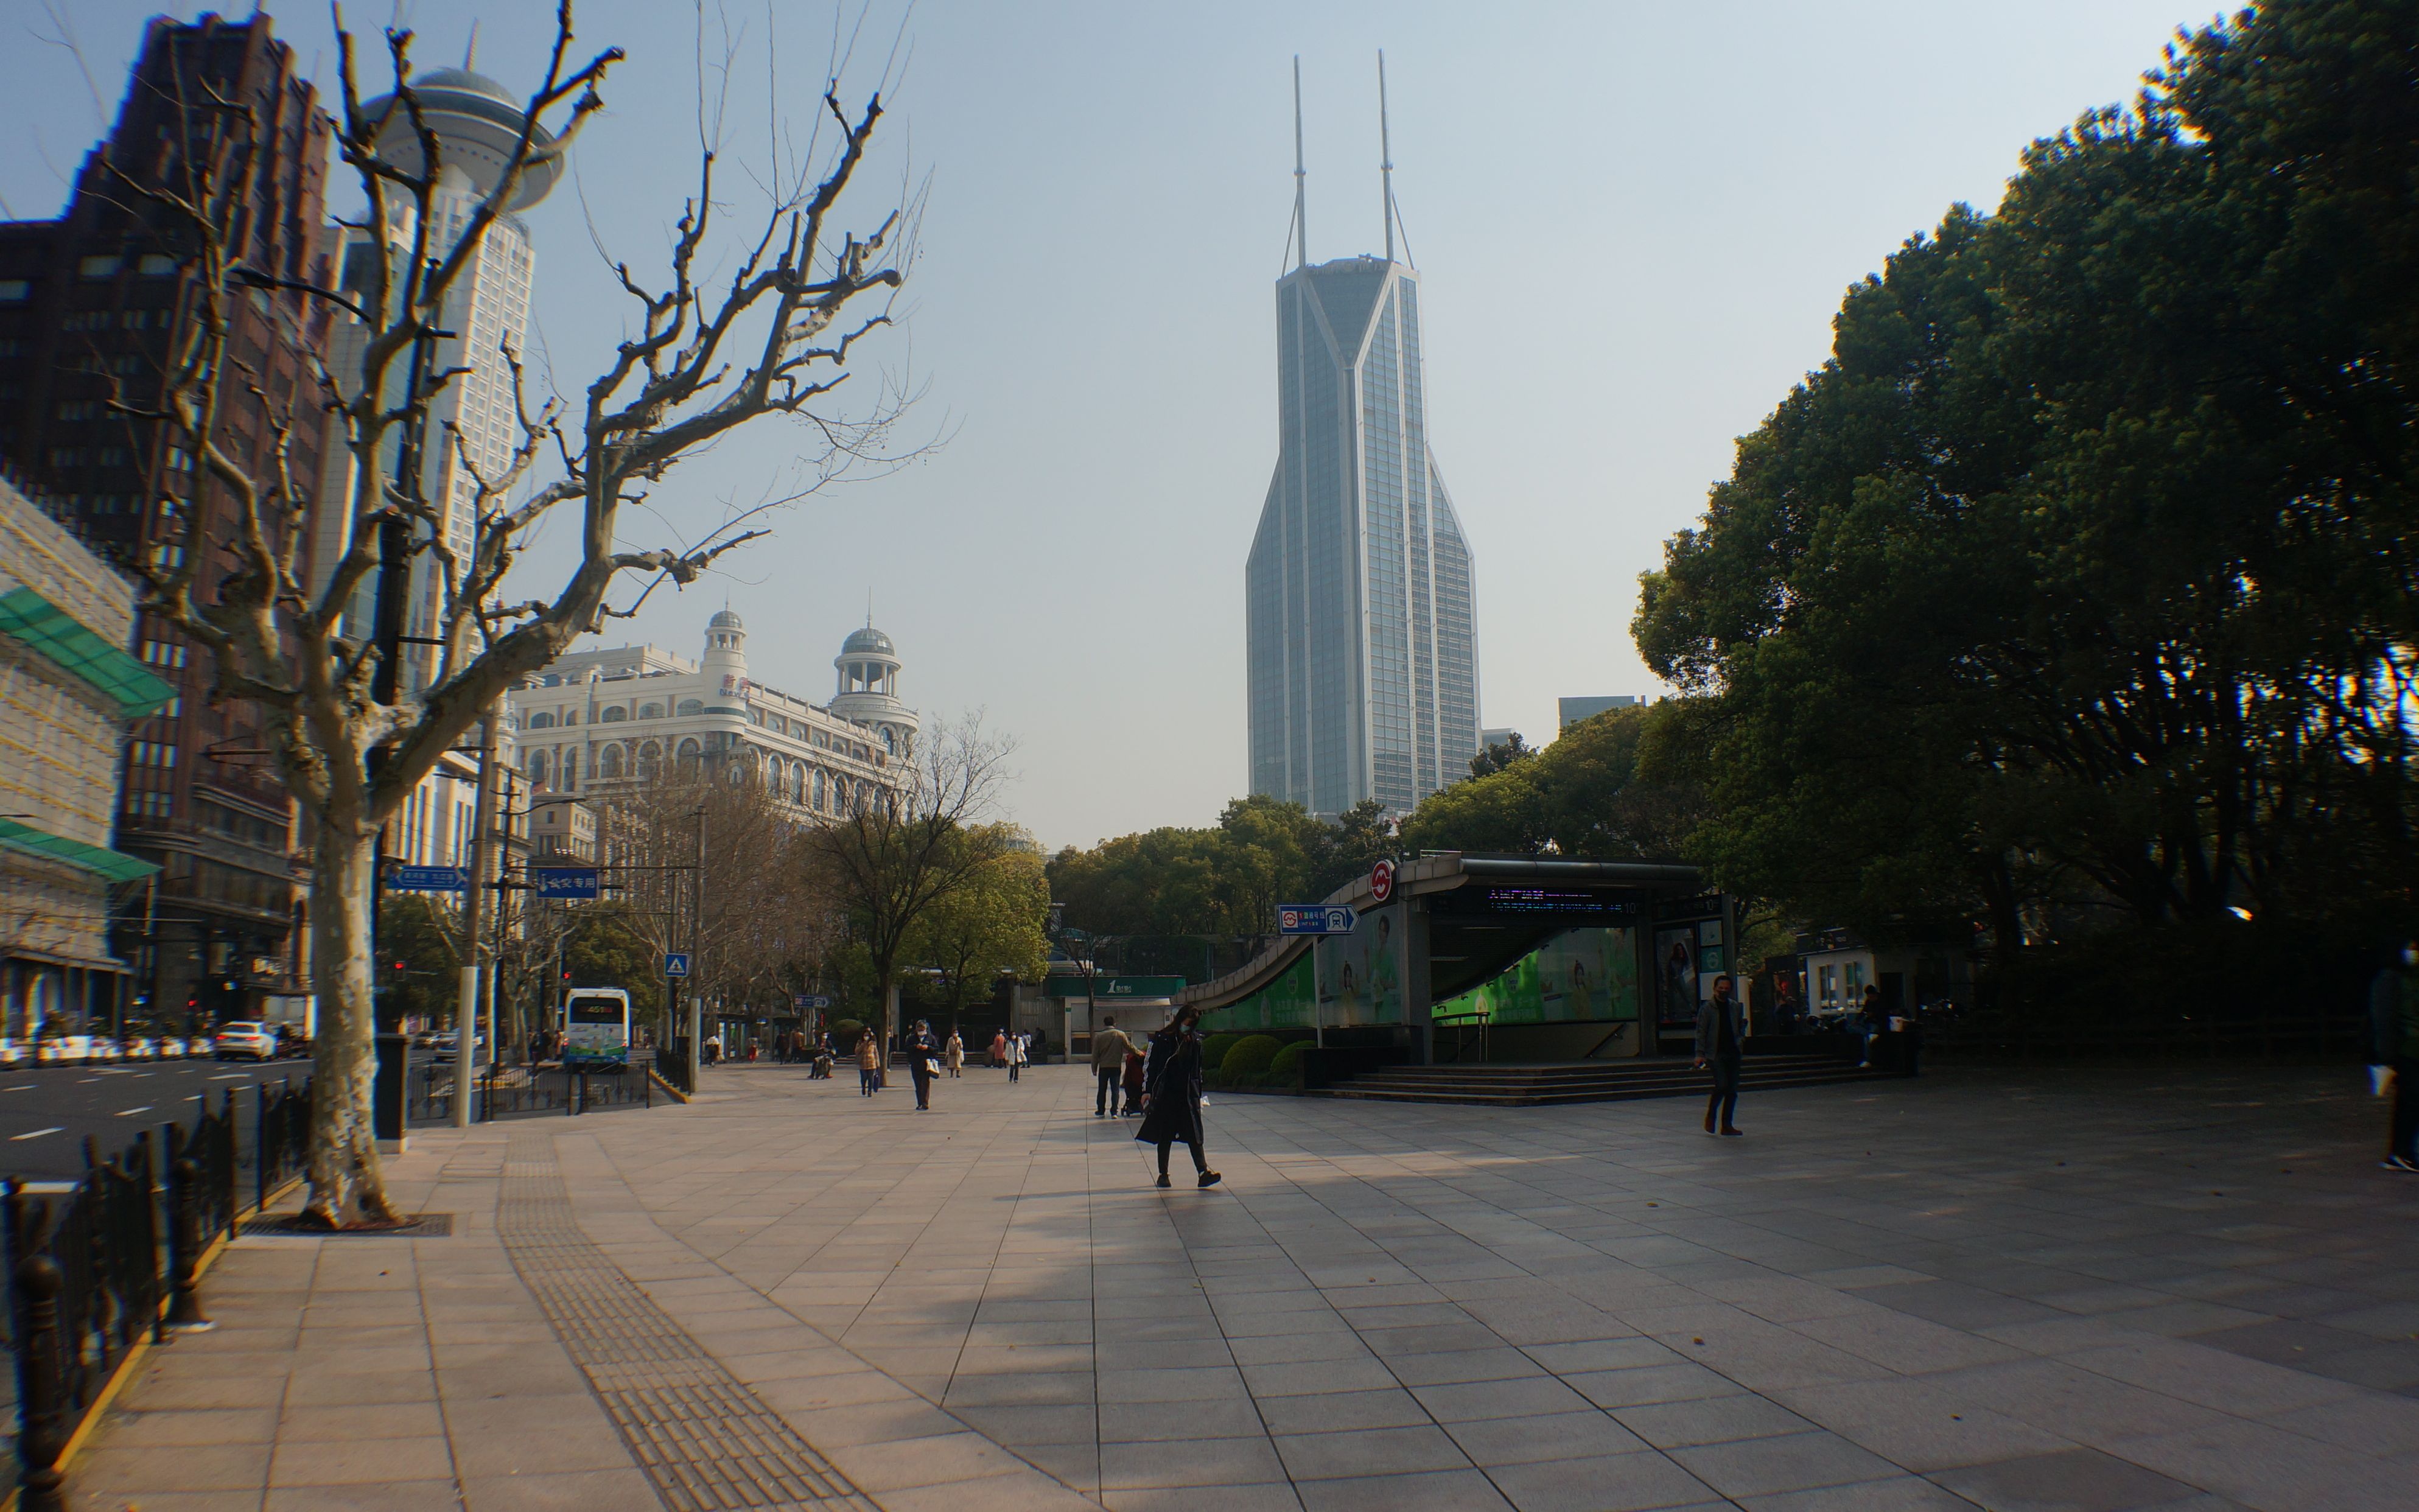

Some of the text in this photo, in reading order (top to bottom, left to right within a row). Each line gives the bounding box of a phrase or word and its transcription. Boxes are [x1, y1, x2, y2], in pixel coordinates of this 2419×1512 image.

[719, 688, 740, 698] New
[548, 878, 595, 889] 公交专用
[1626, 903, 1636, 914] 10
[1107, 979, 1116, 993] 1
